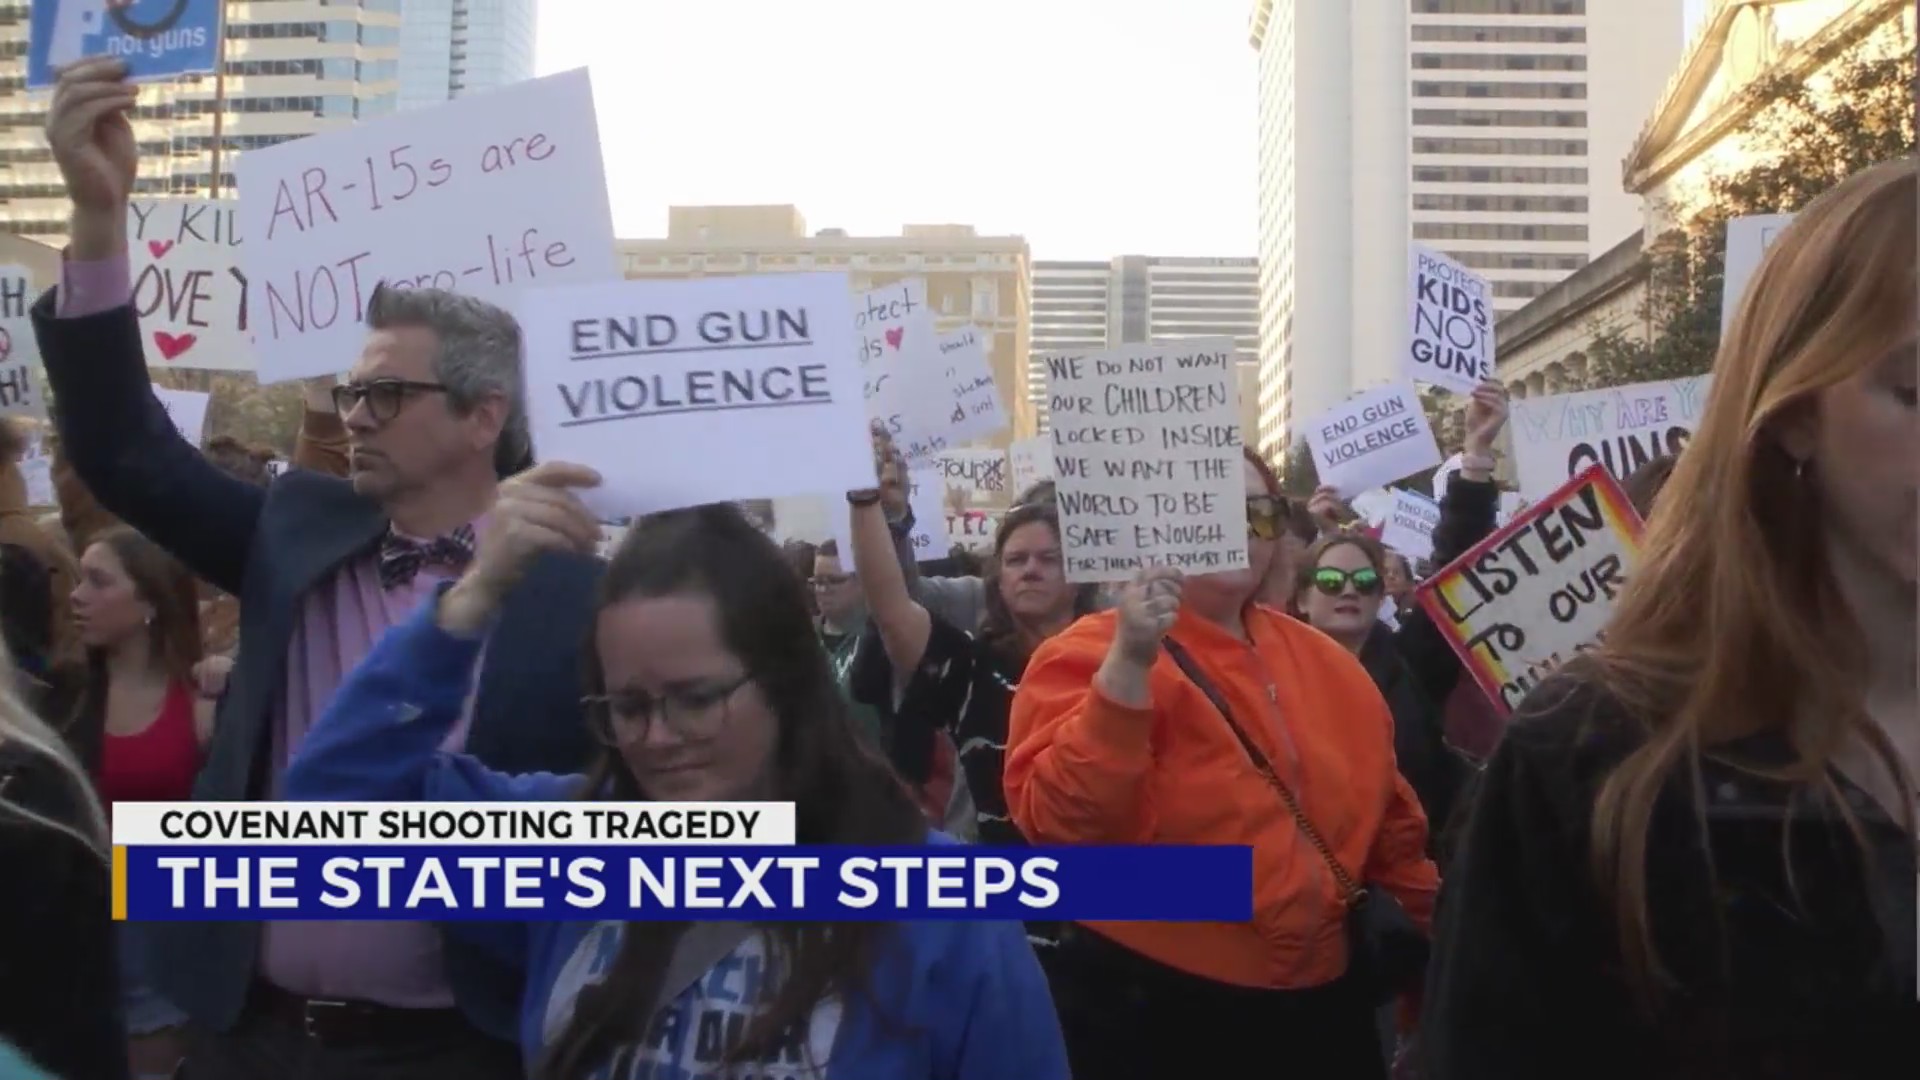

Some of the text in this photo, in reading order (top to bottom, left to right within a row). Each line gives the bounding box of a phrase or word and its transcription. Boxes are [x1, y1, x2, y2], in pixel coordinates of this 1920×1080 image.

[149, 26, 206, 58] guns
[267, 131, 557, 240] AR-15s are
[130, 263, 213, 328] OVE
[266, 251, 371, 341] NOT
[1418, 253, 1486, 297] PROTECT
[855, 287, 919, 330] otect
[1417, 273, 1488, 326] KIDS
[571, 308, 810, 352] END GUN
[1414, 302, 1489, 357] NOT
[1046, 356, 1084, 380] WE
[1129, 356, 1164, 373] NOT
[1177, 353, 1228, 370] WANT
[1411, 339, 1490, 381] GUNS
[557, 364, 831, 418] VIOLENCE
[1051, 382, 1226, 416] OUR CHILDREN
[1613, 390, 1668, 430] ARE
[1054, 424, 1243, 449] LOCKED INSIDE
[1321, 395, 1405, 442] END GUN
[1323, 417, 1419, 466] VIOLENCE
[1055, 456, 1091, 478] WE
[1104, 460, 1176, 480] WANT
[1187, 458, 1233, 481] THE
[1058, 491, 1219, 517] WORLD TO BE
[1066, 523, 1225, 549] SAFE ENOUGH
[1436, 483, 1604, 623] LISTEN
[1466, 553, 1627, 662] TO OUR
